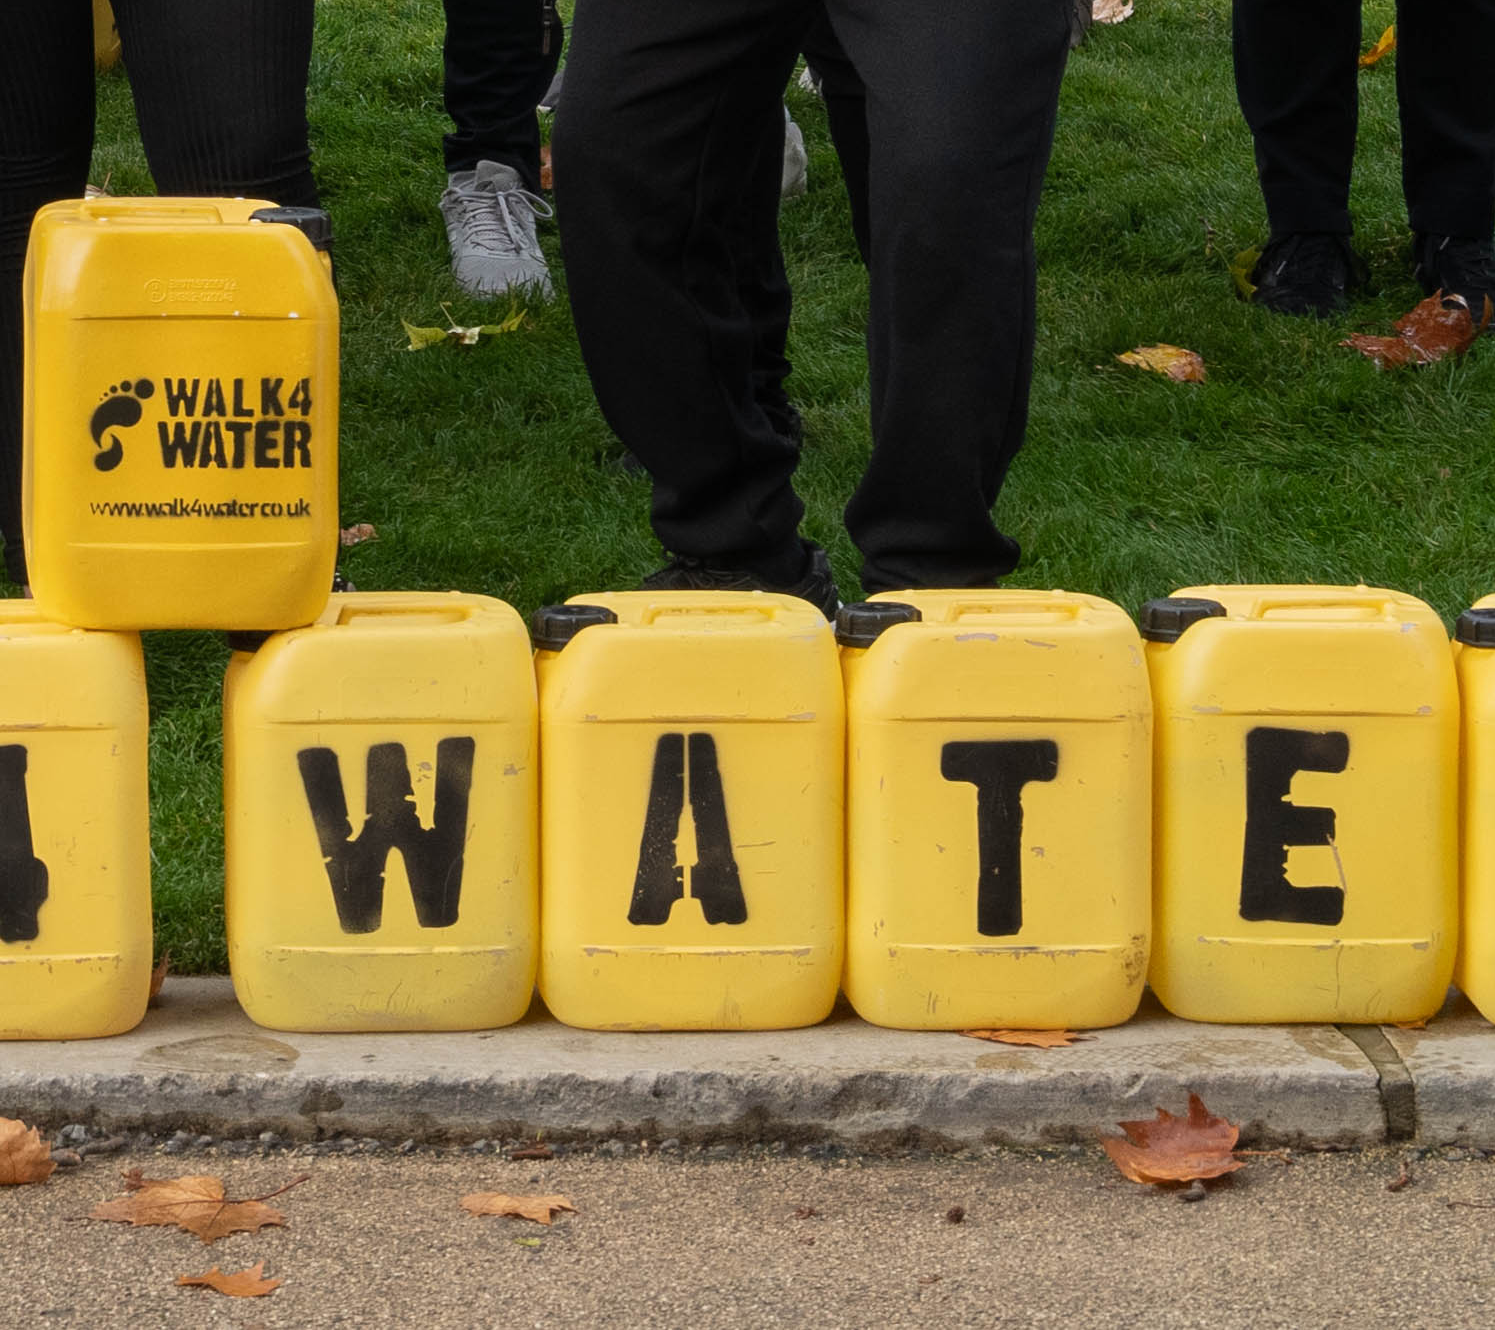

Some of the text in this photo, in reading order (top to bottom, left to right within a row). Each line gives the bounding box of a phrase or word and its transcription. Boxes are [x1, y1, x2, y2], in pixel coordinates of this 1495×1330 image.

[164, 376, 314, 418] WALK4
[157, 419, 314, 470] WATER
[90, 498, 312, 519] www.walk4water.co.uk
